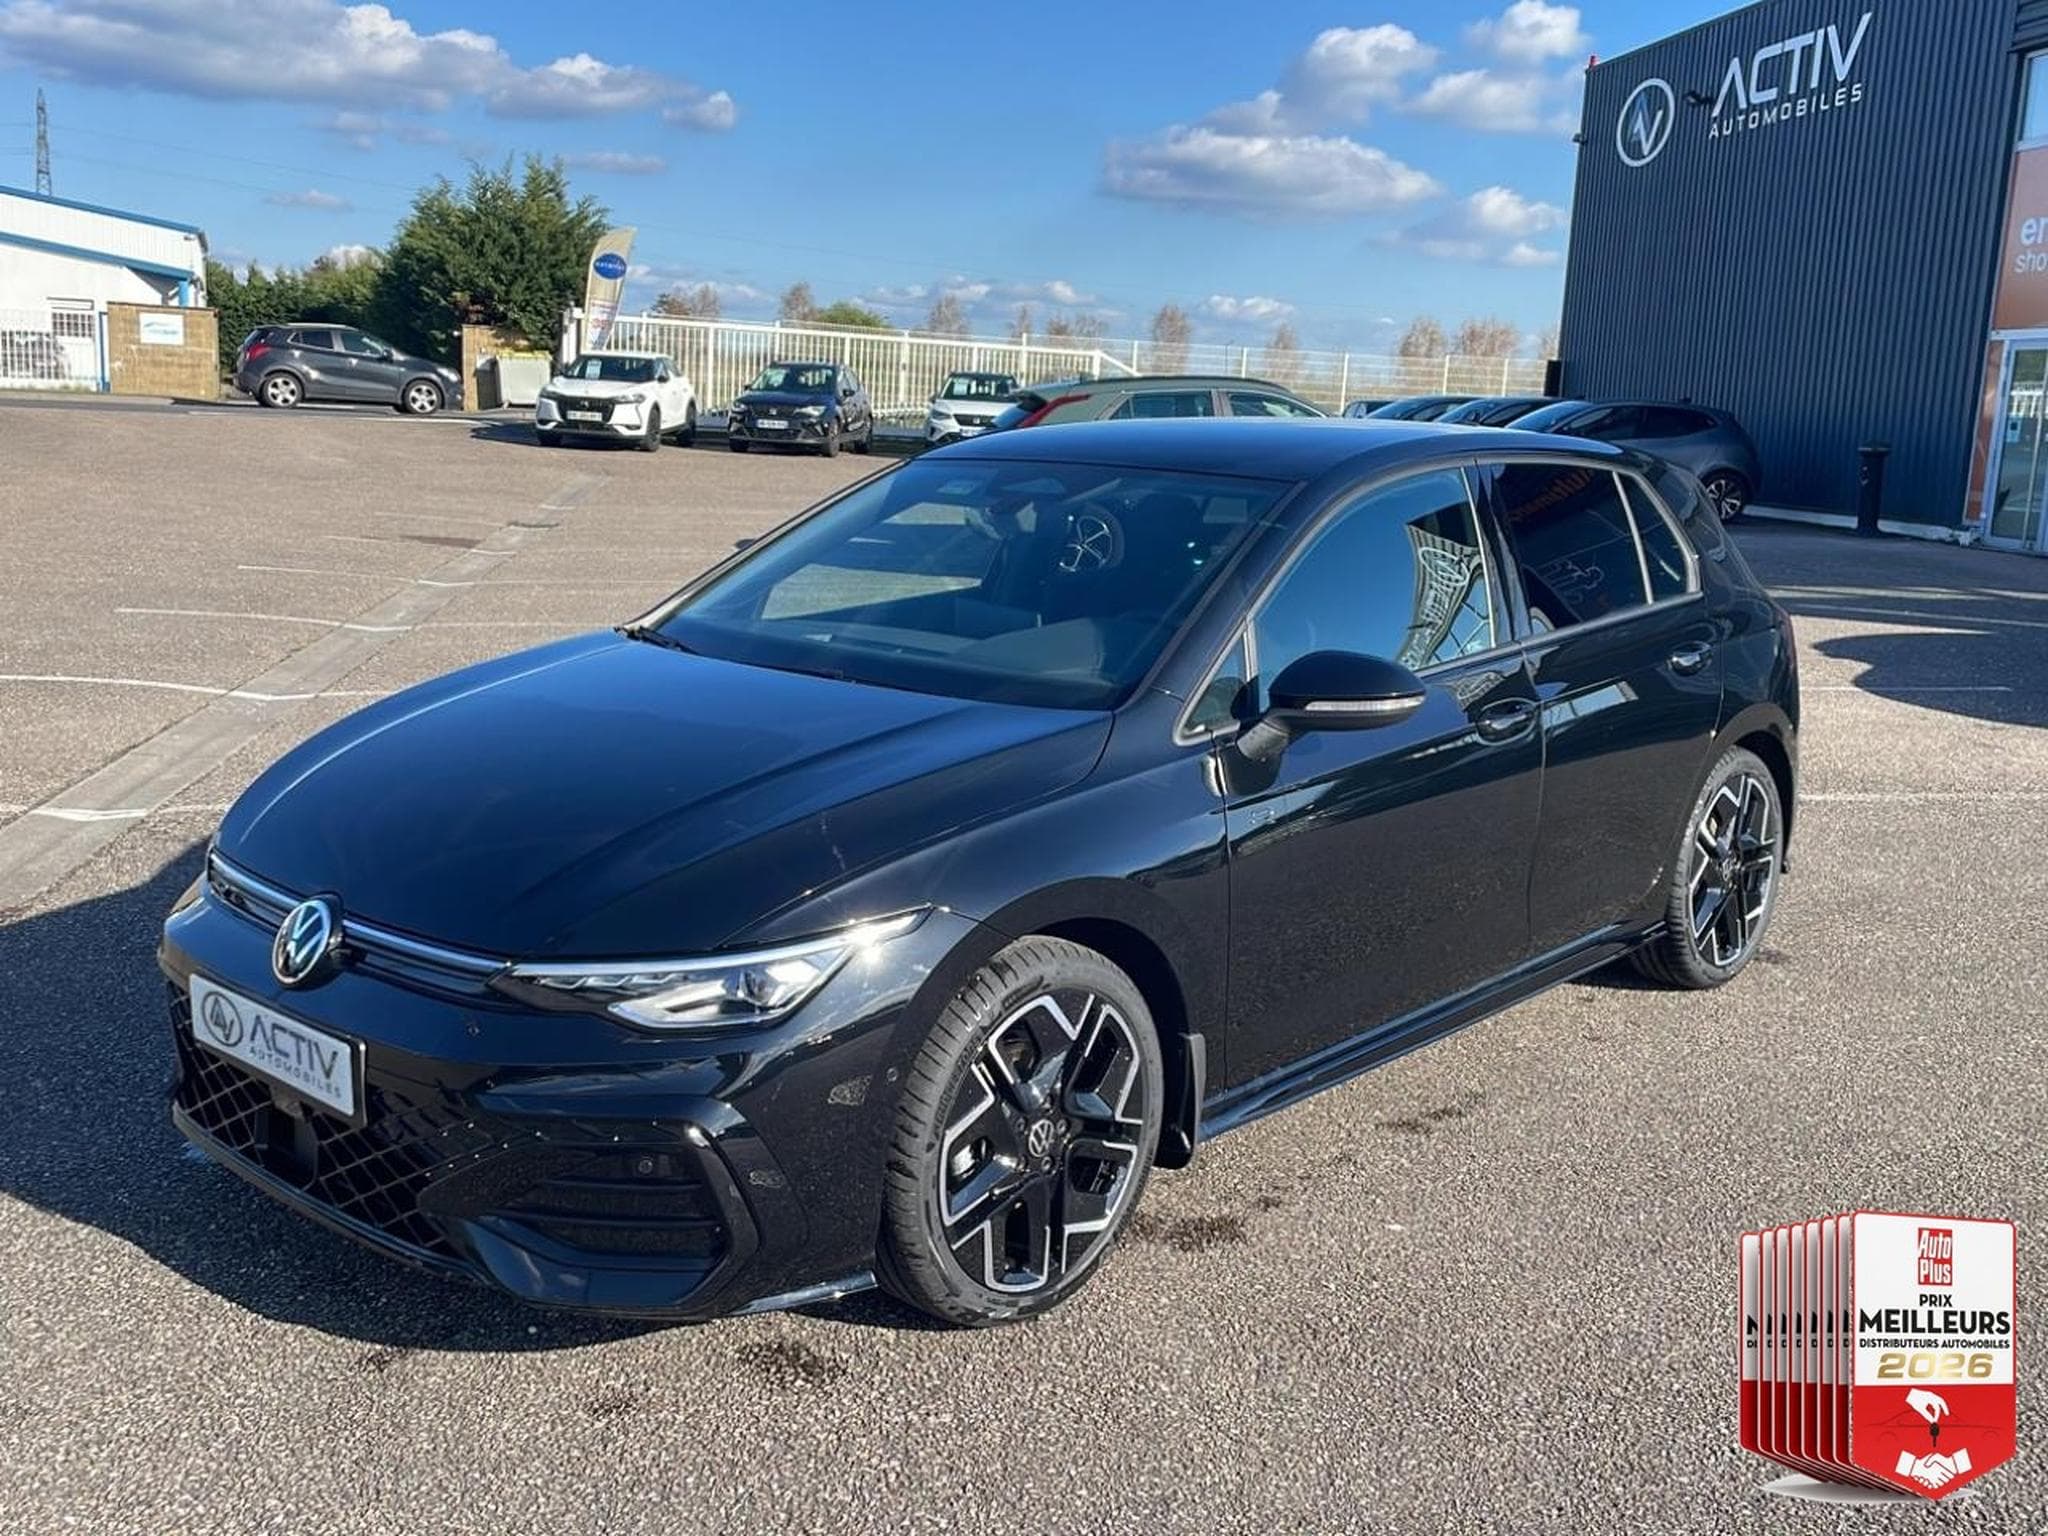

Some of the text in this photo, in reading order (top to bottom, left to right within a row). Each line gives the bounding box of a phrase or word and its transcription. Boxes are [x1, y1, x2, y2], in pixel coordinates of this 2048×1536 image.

[1712, 12, 1873, 118] ACTIV
[1708, 83, 1863, 139] AUTOMOBILES
[249, 1047, 341, 1097] AUTOMOBILES
[250, 1015, 338, 1079] ACTIV
